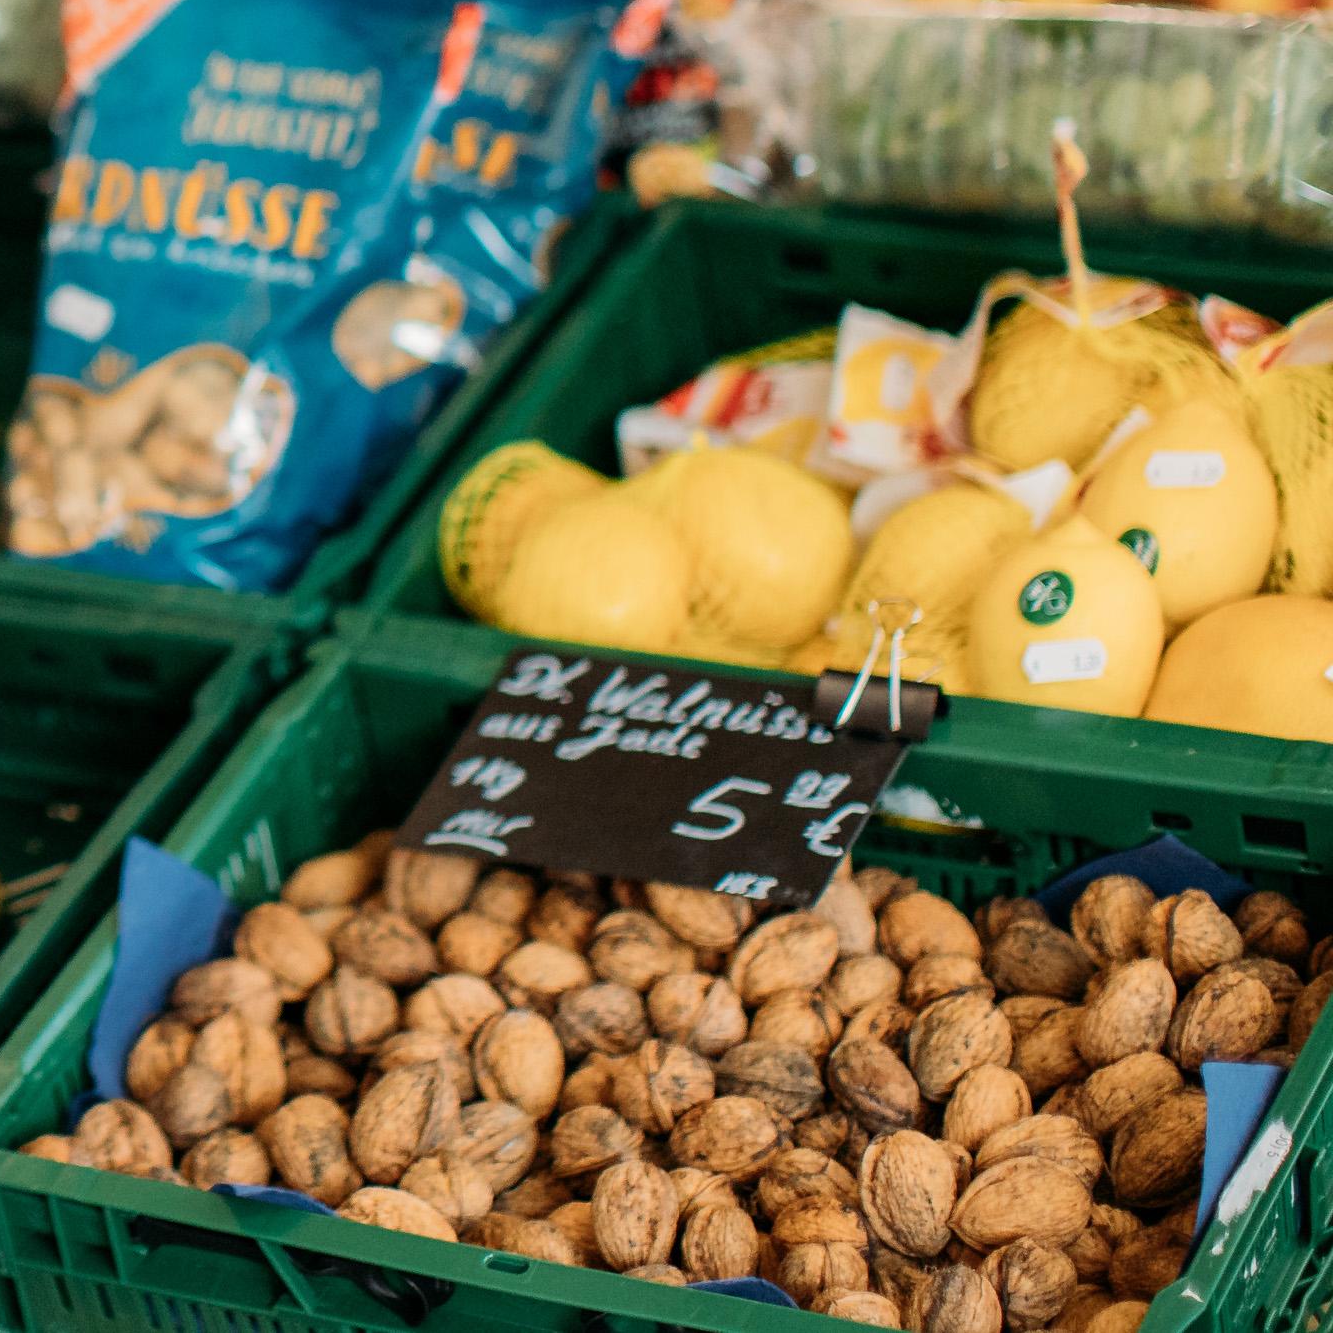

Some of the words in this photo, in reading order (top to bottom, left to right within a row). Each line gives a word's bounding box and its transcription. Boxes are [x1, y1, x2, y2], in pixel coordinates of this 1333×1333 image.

[477, 713, 565, 743] aus
[669, 774, 774, 842] 5
[801, 799, 870, 858] €
